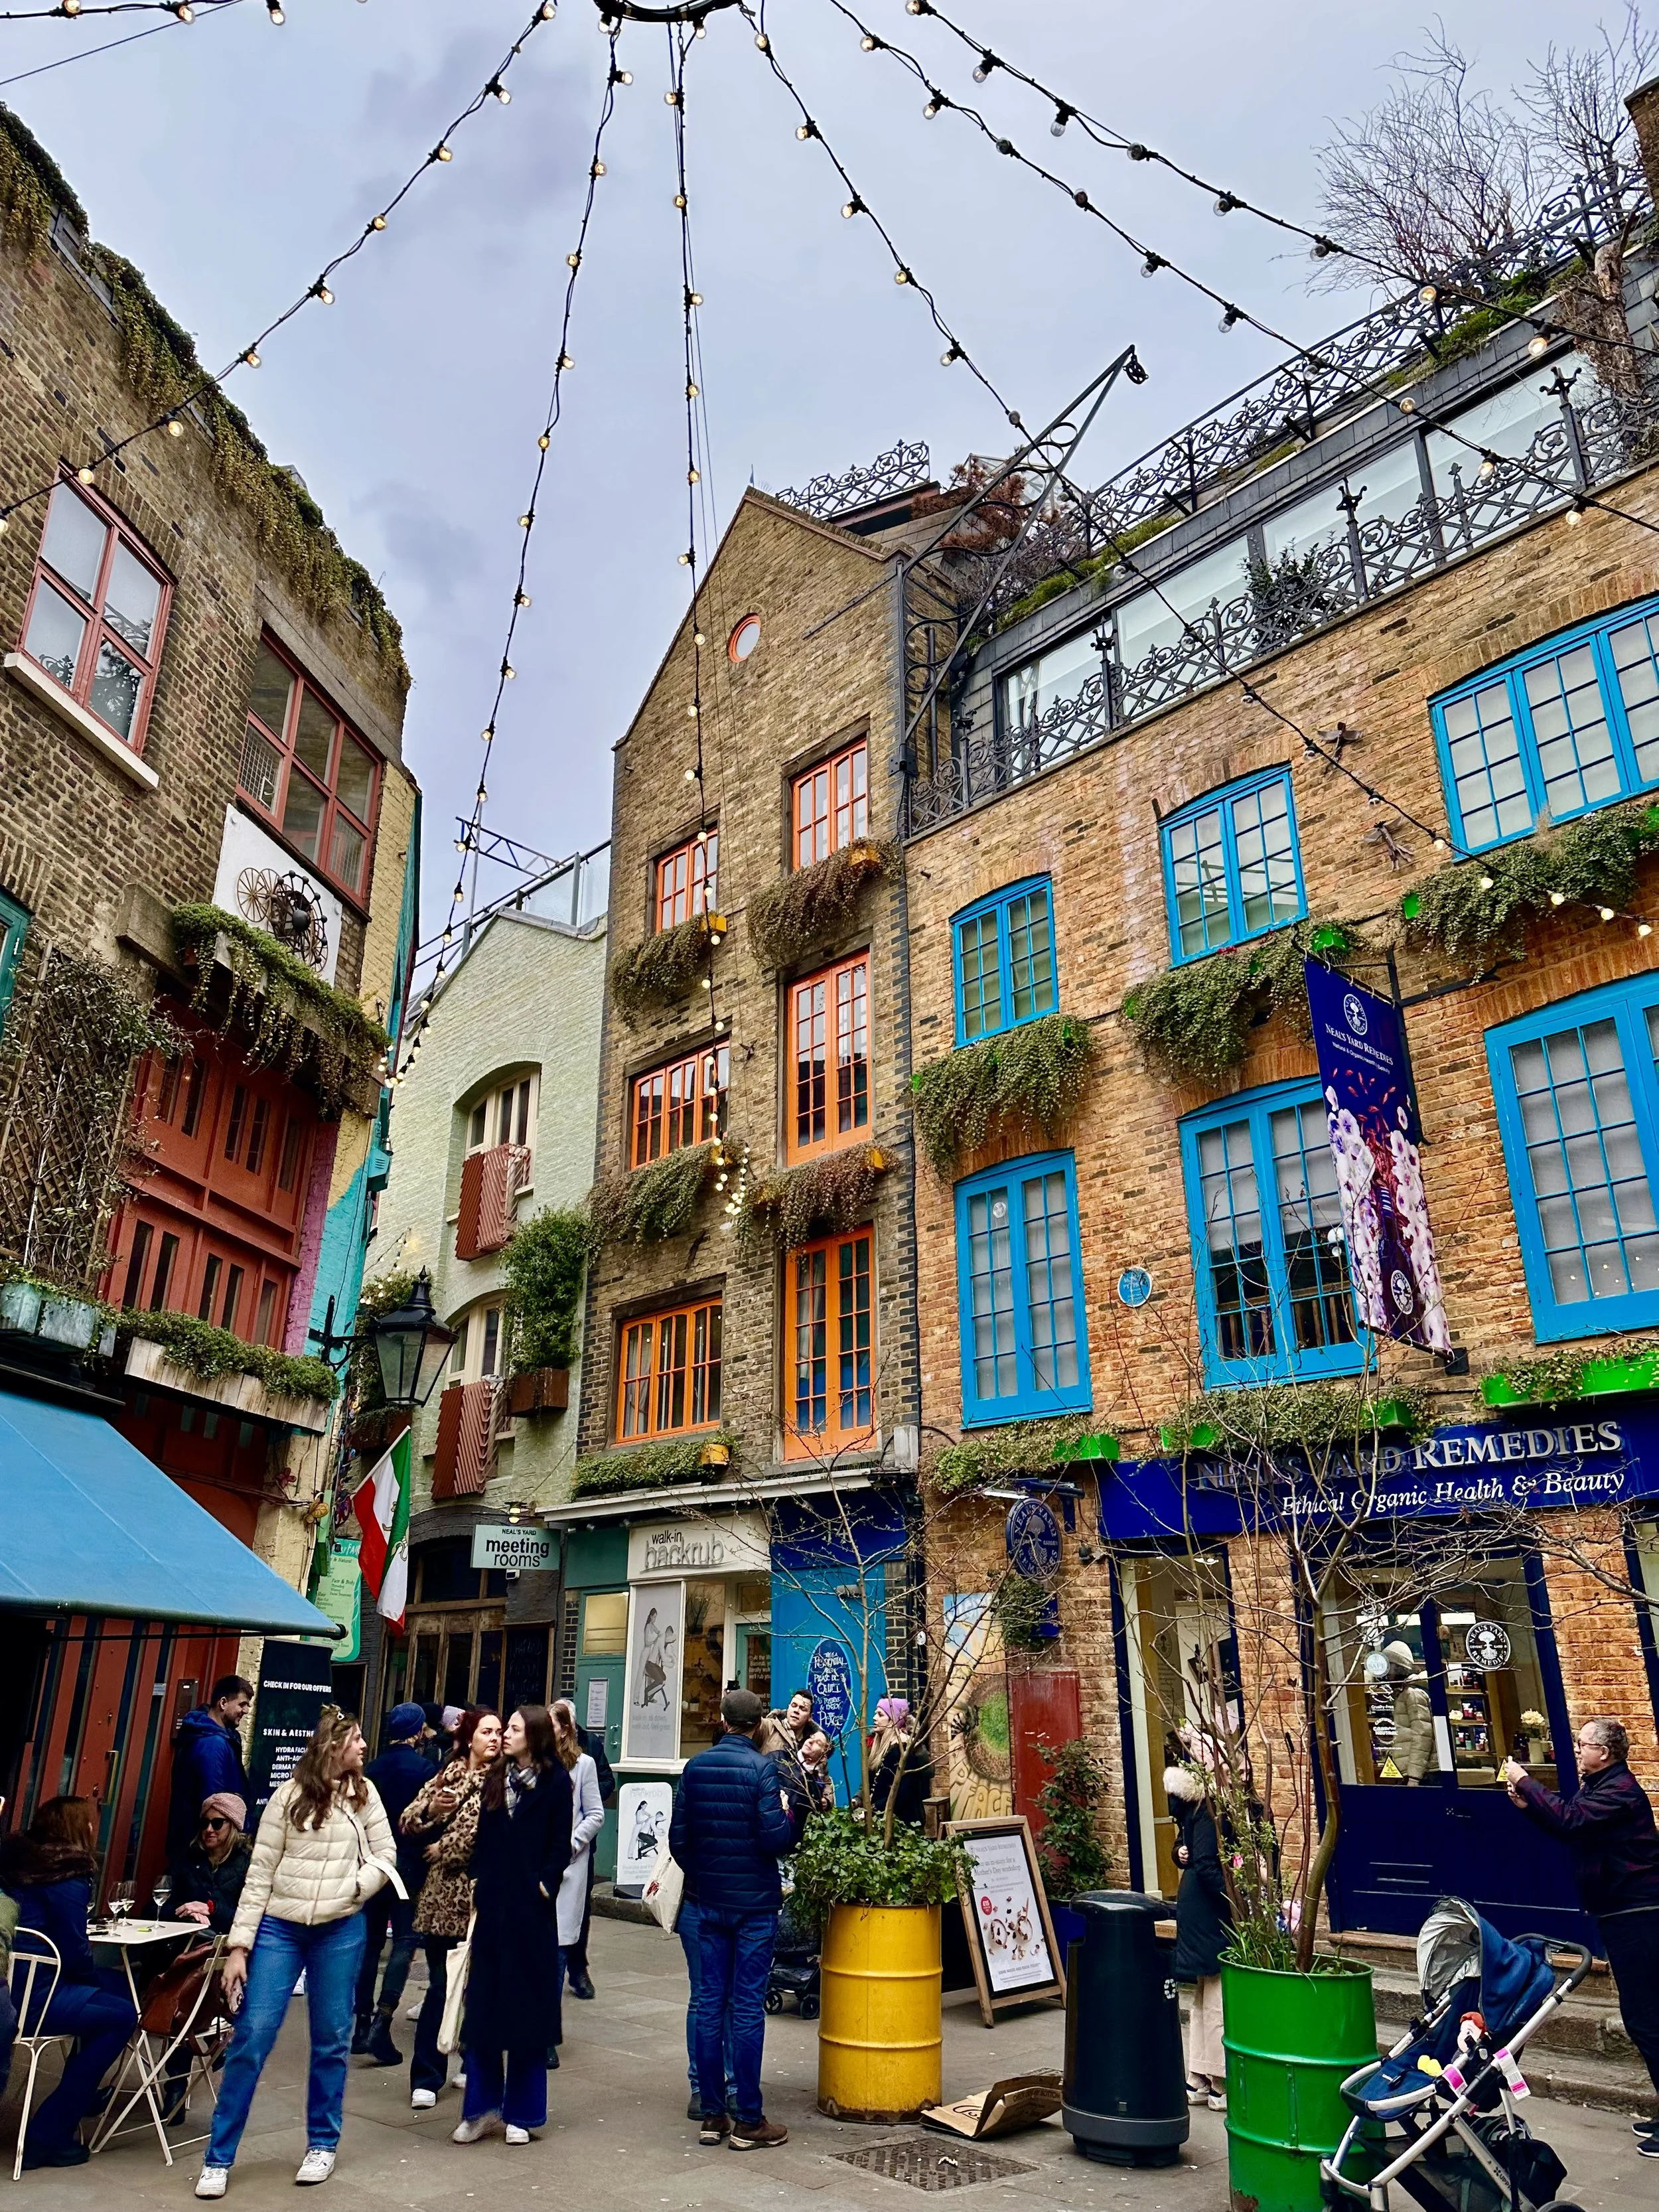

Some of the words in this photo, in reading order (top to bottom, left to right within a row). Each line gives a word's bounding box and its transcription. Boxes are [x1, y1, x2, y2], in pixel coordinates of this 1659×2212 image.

[1325, 1023, 1346, 1042] NEAL'S
[1346, 1034, 1363, 1050] YARD
[1311, 1445, 1404, 1481] YARD
[1413, 1421, 1623, 1470] REMEDIES
[1281, 1492, 1344, 1516] Ethical
[1433, 1478, 1504, 1503] Health
[1512, 1475, 1536, 1496] &
[1544, 1471, 1624, 1495] Beauty
[652, 1528, 682, 1544] walk-in
[486, 1538, 549, 1558] meeting
[644, 1533, 724, 1569] backrub
[494, 1554, 540, 1567] rooms
[1469, 1625, 1487, 1644] NEAL'S
[263, 1680, 283, 1689] CHECK
[313, 1684, 332, 1693] OFFERS
